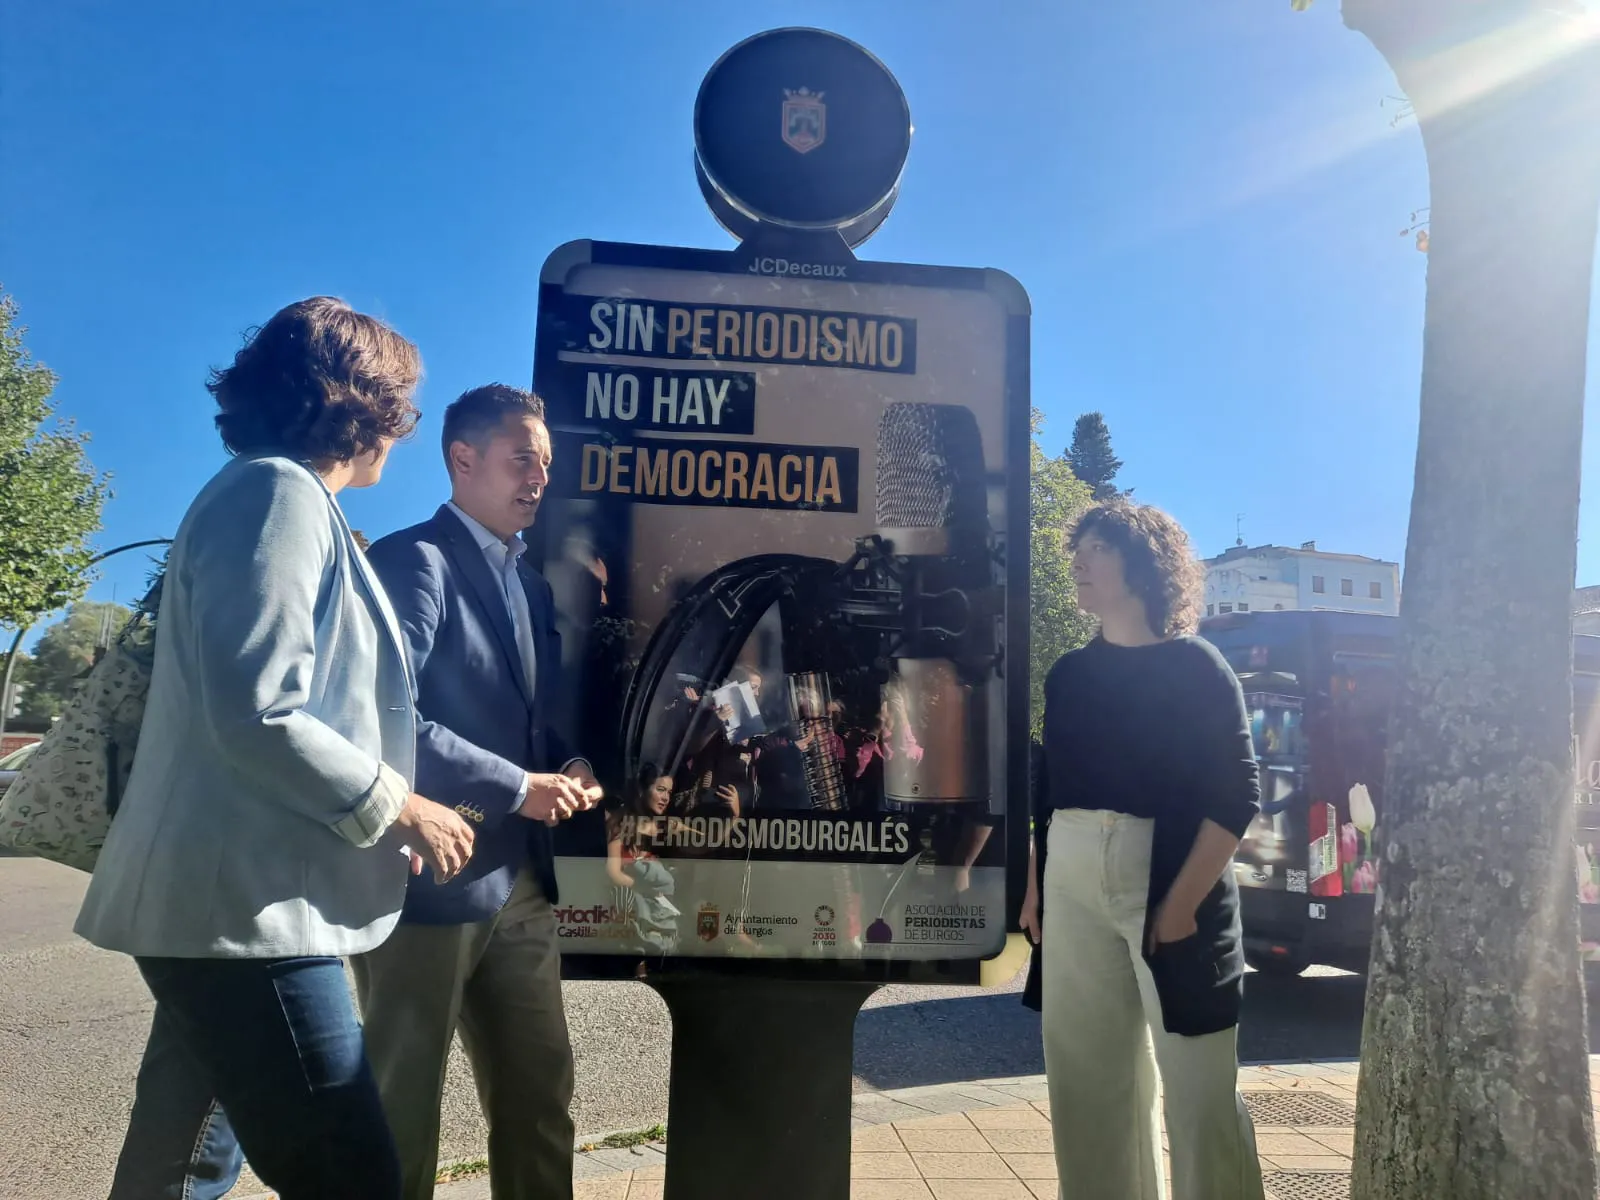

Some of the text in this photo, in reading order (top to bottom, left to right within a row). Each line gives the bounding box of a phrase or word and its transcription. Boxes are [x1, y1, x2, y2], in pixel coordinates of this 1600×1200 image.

[749, 257, 847, 278] JCDecaux
[588, 302, 903, 368] SIN PERIODISMO
[585, 371, 731, 426] NO HAY
[580, 443, 842, 504] DEMOCRACIA
[620, 815, 909, 853] #PERIODISMOBURGALÉS
[905, 904, 986, 917] ASOCIACIÓN DE
[724, 913, 798, 925] Ayuntamiento
[905, 917, 986, 929] PERIODISTAS
[557, 926, 598, 938] Castilla
[723, 925, 773, 938] de Burgos
[812, 932, 836, 940] 2030
[904, 929, 965, 941] DE BURGOS
